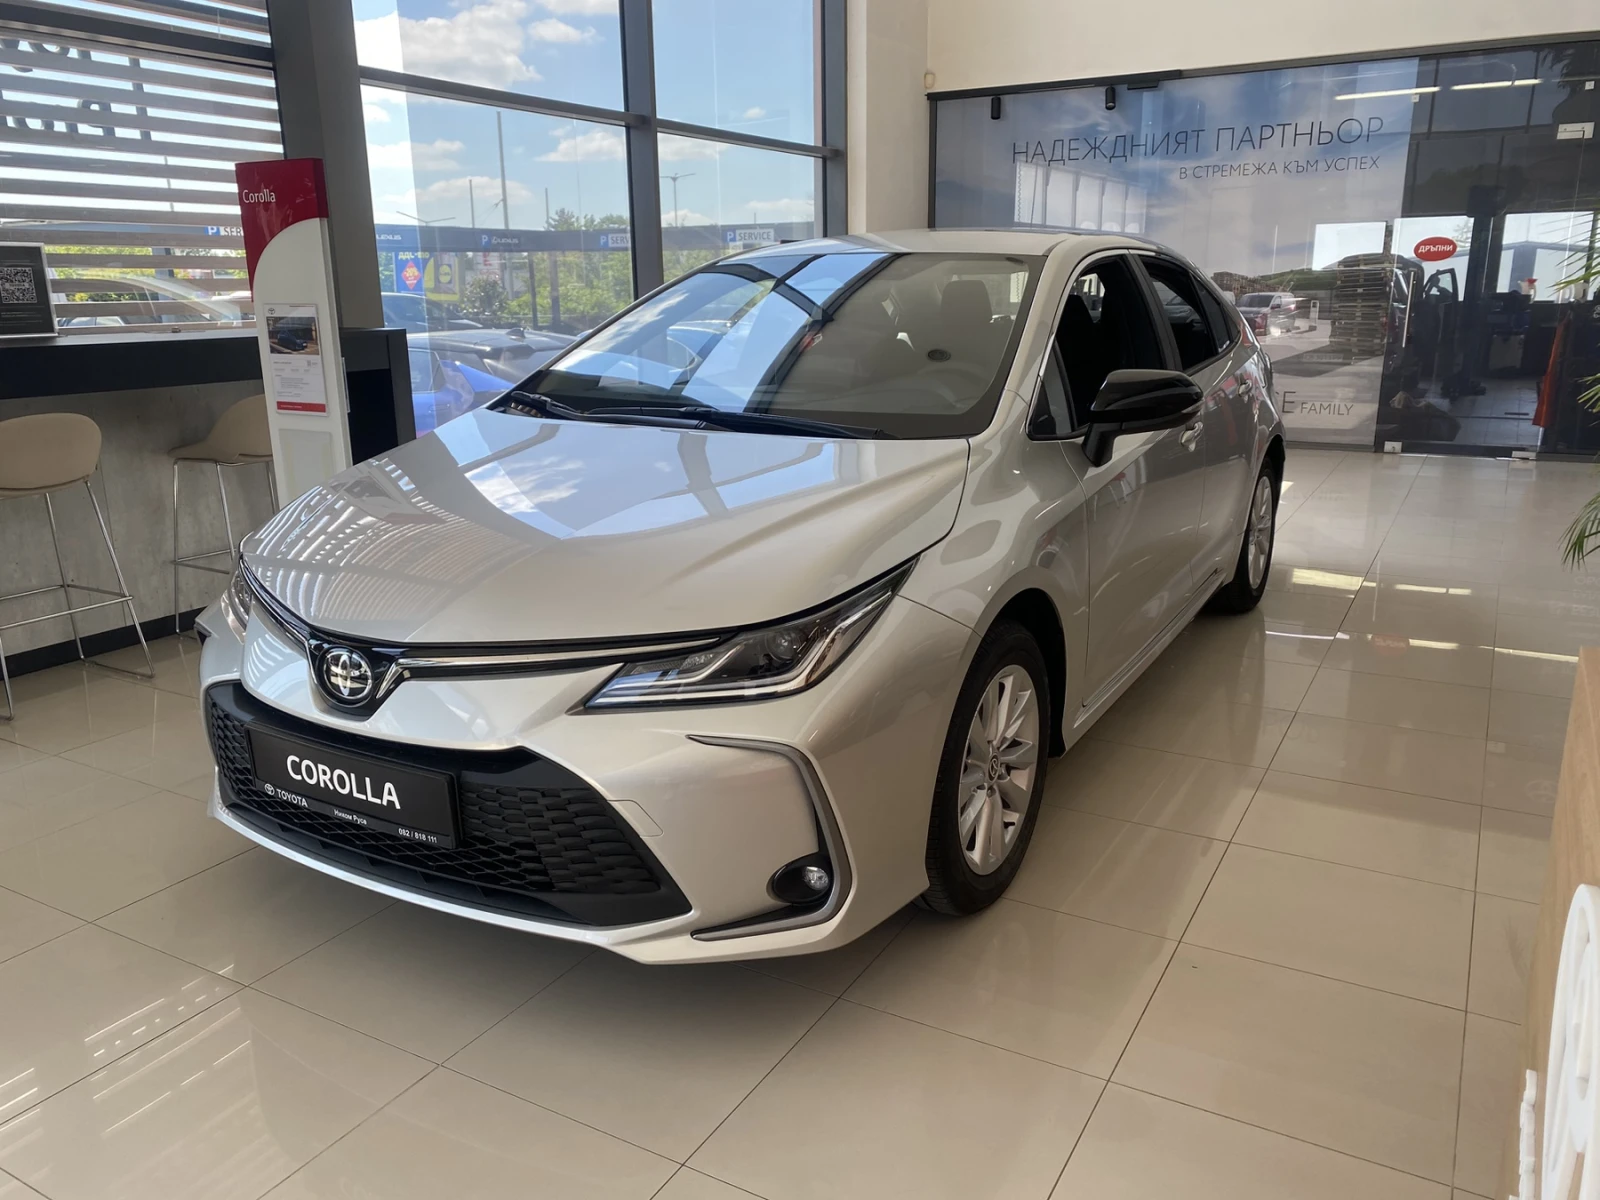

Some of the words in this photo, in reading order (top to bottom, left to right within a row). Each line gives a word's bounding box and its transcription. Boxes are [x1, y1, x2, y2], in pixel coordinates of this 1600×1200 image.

[1012, 129, 1206, 167] НАДЕЖДНИЯТ
[1216, 117, 1384, 152] ПАРТНЬОР
[1179, 166, 1188, 180] В
[1192, 161, 1278, 179] СТРЕМЕЖА
[1283, 159, 1319, 174] КЪМ
[1324, 155, 1381, 172] УСПЕХ
[242, 188, 276, 203] Corolla
[727, 231, 735, 242] P
[738, 231, 772, 241] SERVICE
[1418, 244, 1454, 253] ДРЪПНИ
[1300, 401, 1354, 416] FAMILY
[286, 754, 401, 809] COROLLA
[276, 788, 308, 808] TOYOTA
[398, 827, 410, 837] 082
[414, 831, 427, 841] 818
[427, 834, 438, 844] 111
